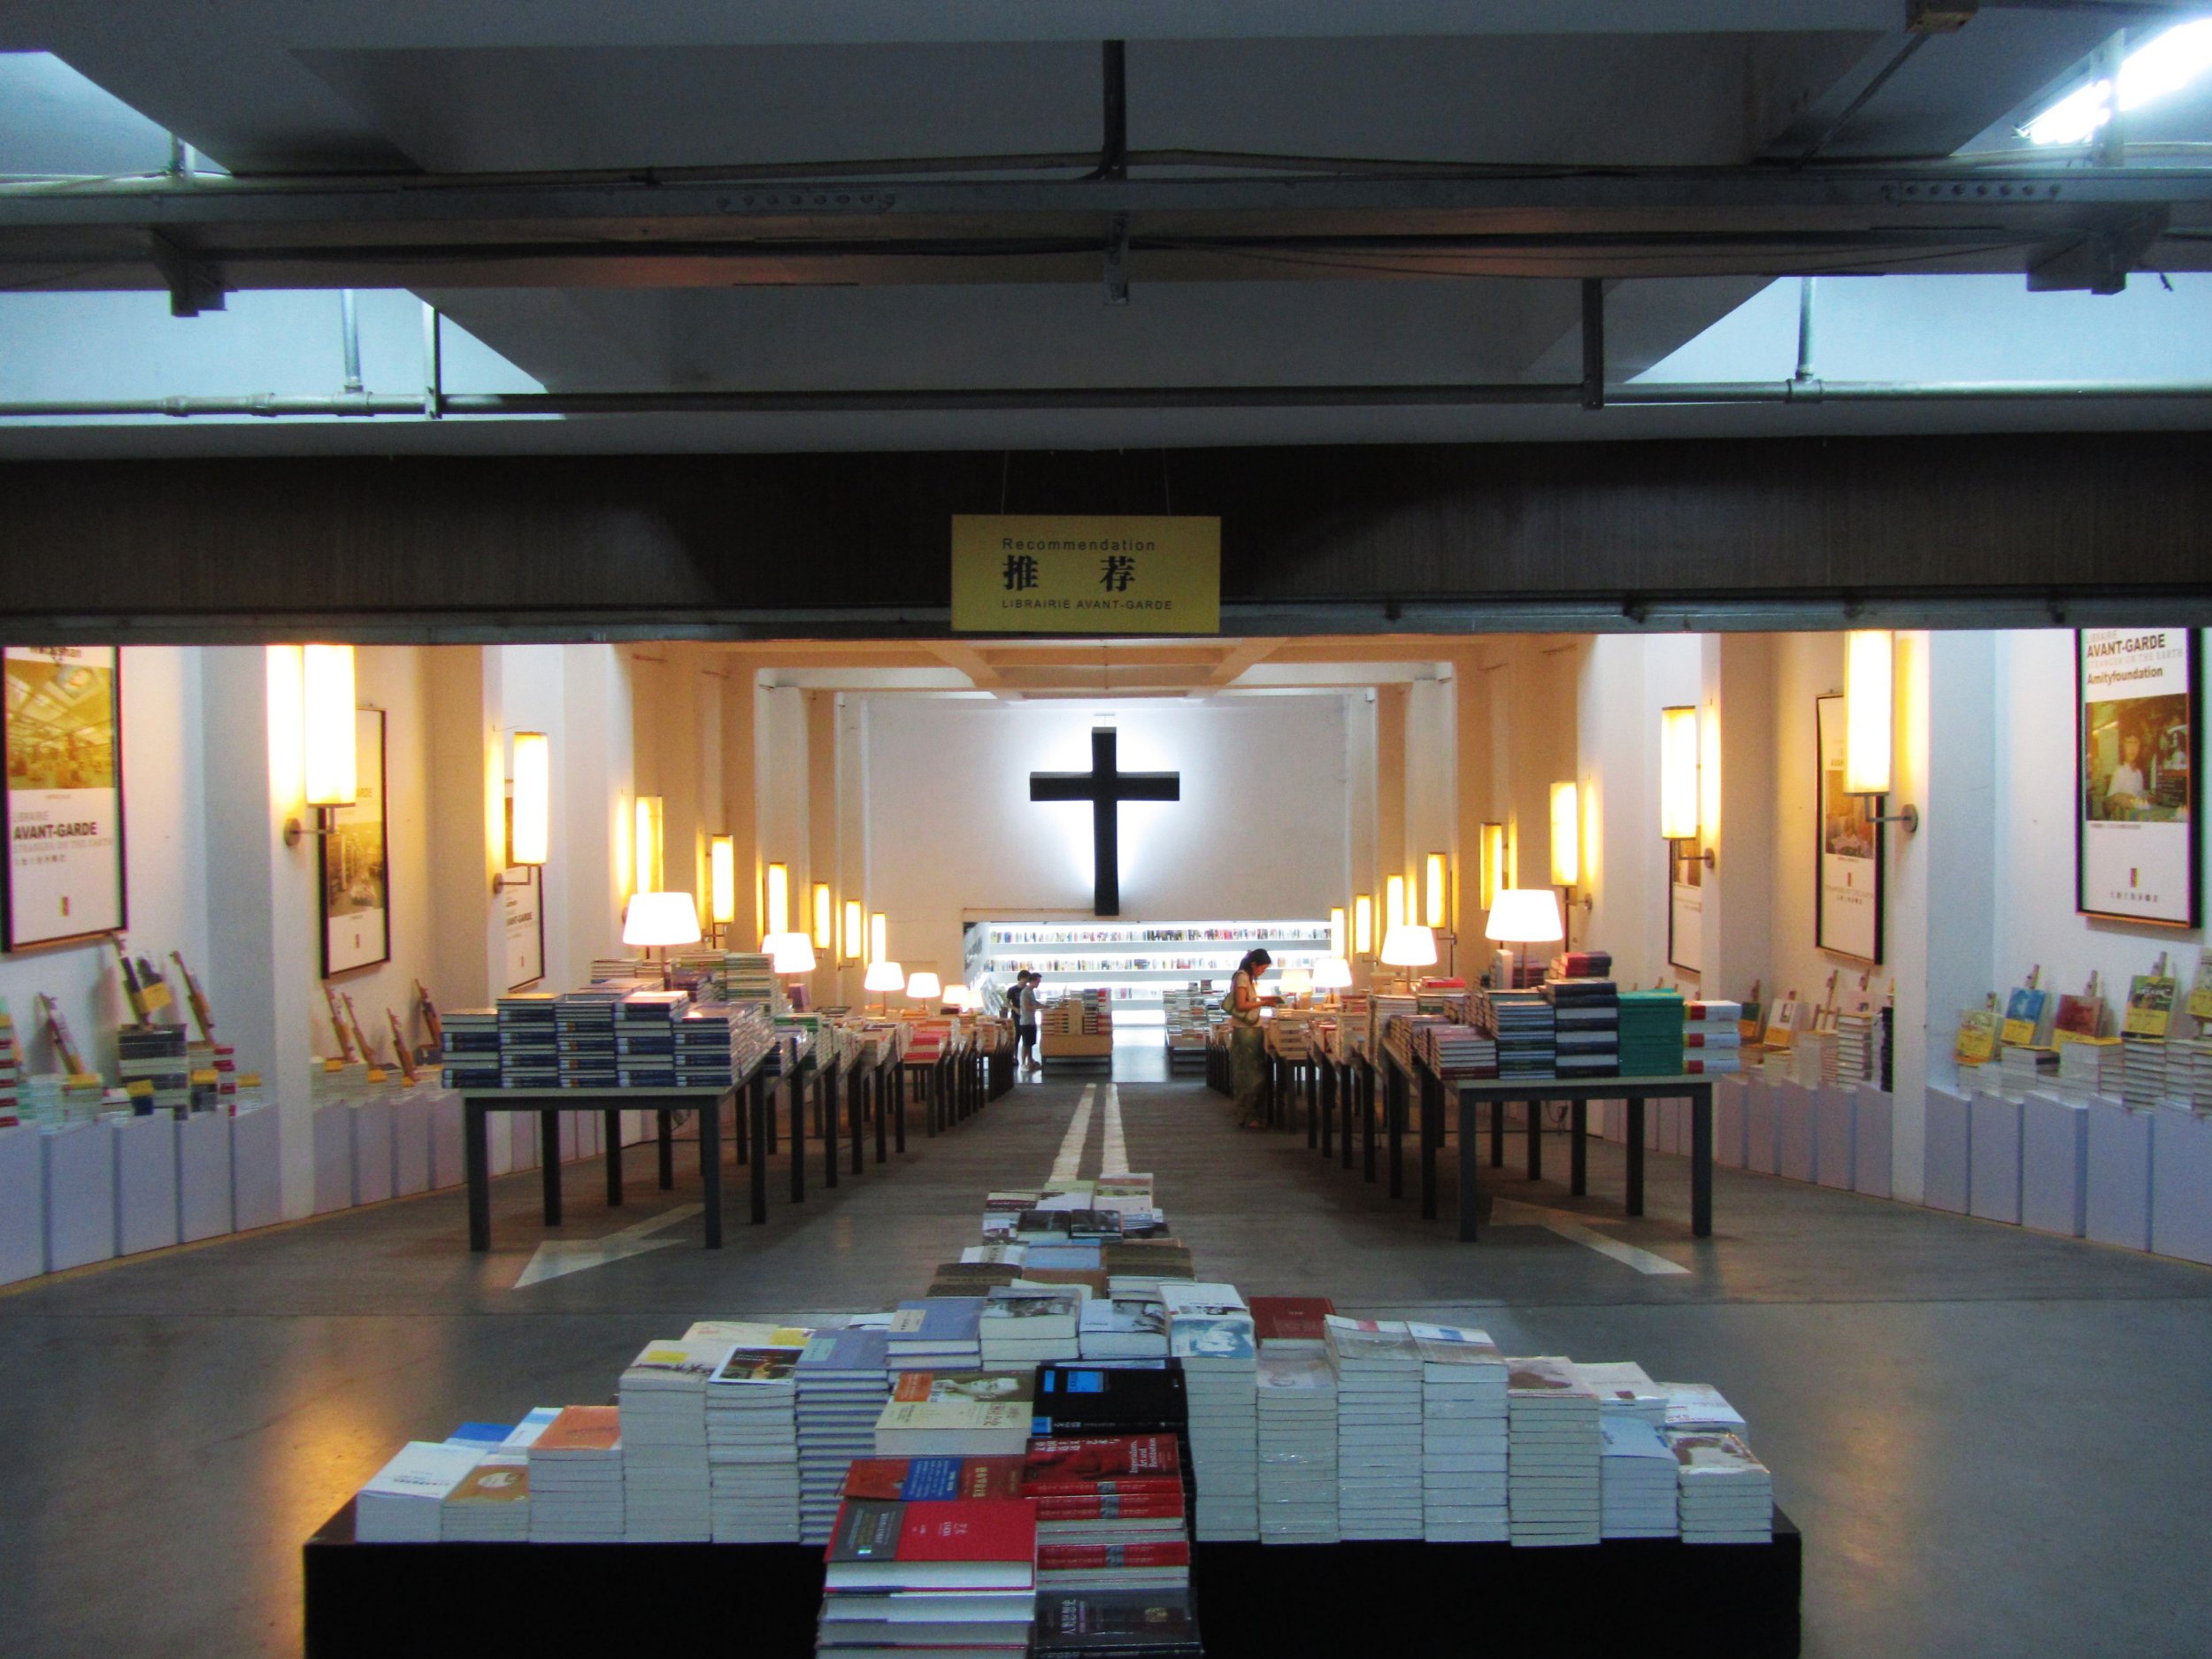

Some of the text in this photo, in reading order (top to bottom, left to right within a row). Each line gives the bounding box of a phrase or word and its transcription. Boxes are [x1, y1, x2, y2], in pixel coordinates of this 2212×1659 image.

[1002, 537, 1156, 551] Recommendation
[1002, 599, 1172, 611] LIBRAIRIE AVANT-GARDE
[2087, 634, 2165, 657] AVANT-GARDE
[2087, 666, 2163, 686] Amityfoundation
[14, 823, 97, 840] AVANT-GARDE
